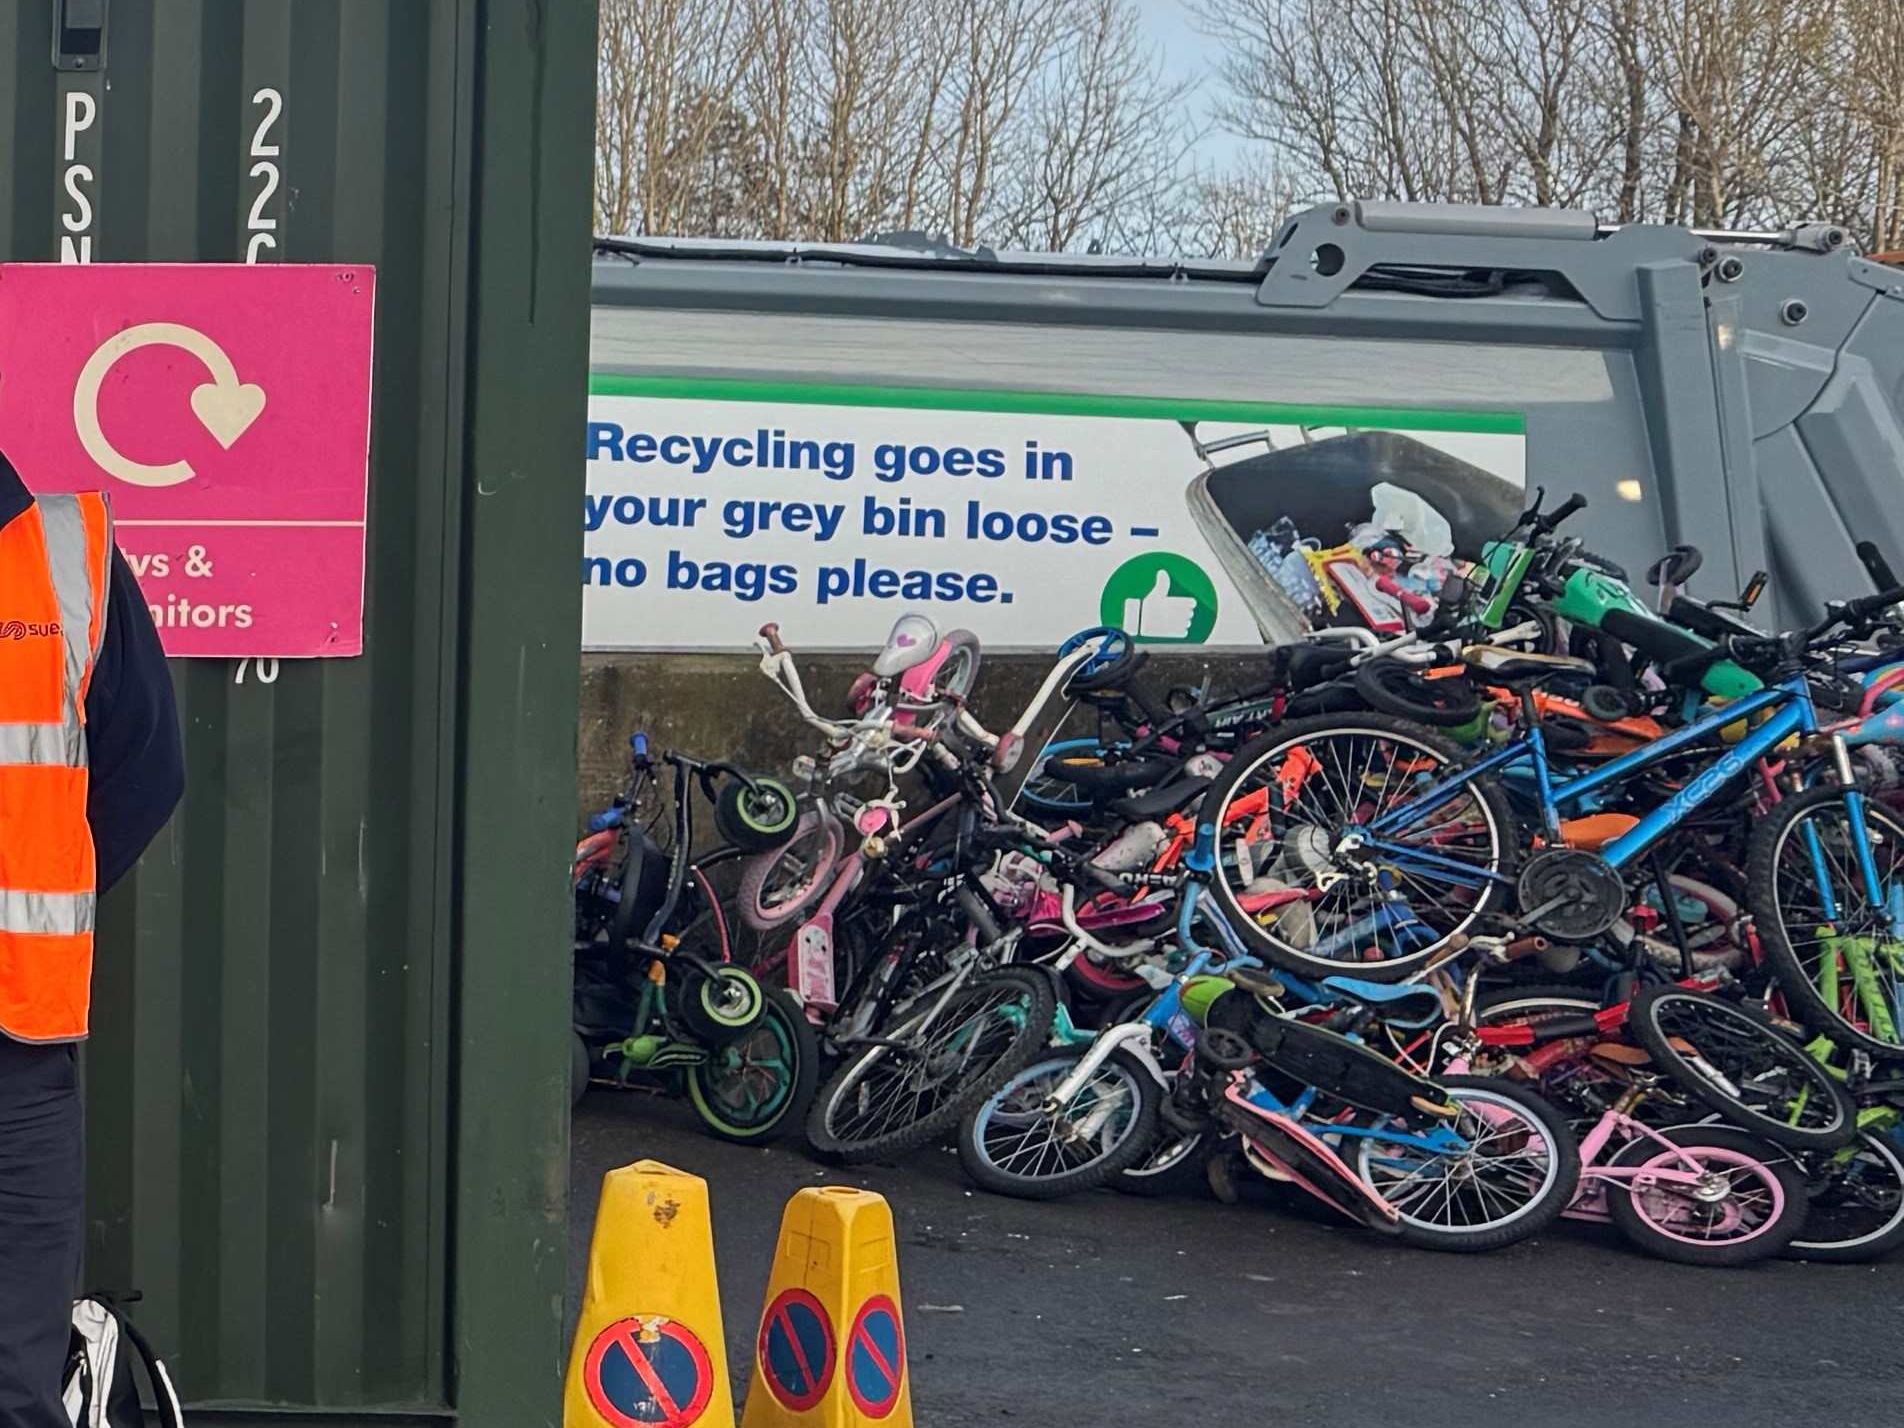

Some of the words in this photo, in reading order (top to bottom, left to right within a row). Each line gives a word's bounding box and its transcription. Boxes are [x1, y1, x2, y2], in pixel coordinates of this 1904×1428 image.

[586, 421, 855, 482] Recycling
[874, 438, 1006, 483] goes
[1025, 440, 1074, 481] in
[583, 494, 707, 532] your
[723, 500, 846, 541] grey
[863, 495, 947, 539] bin
[966, 500, 1114, 546] loose
[184, 544, 214, 578] &
[583, 556, 647, 589] no
[667, 550, 798, 601] bags
[816, 558, 1015, 605] please.
